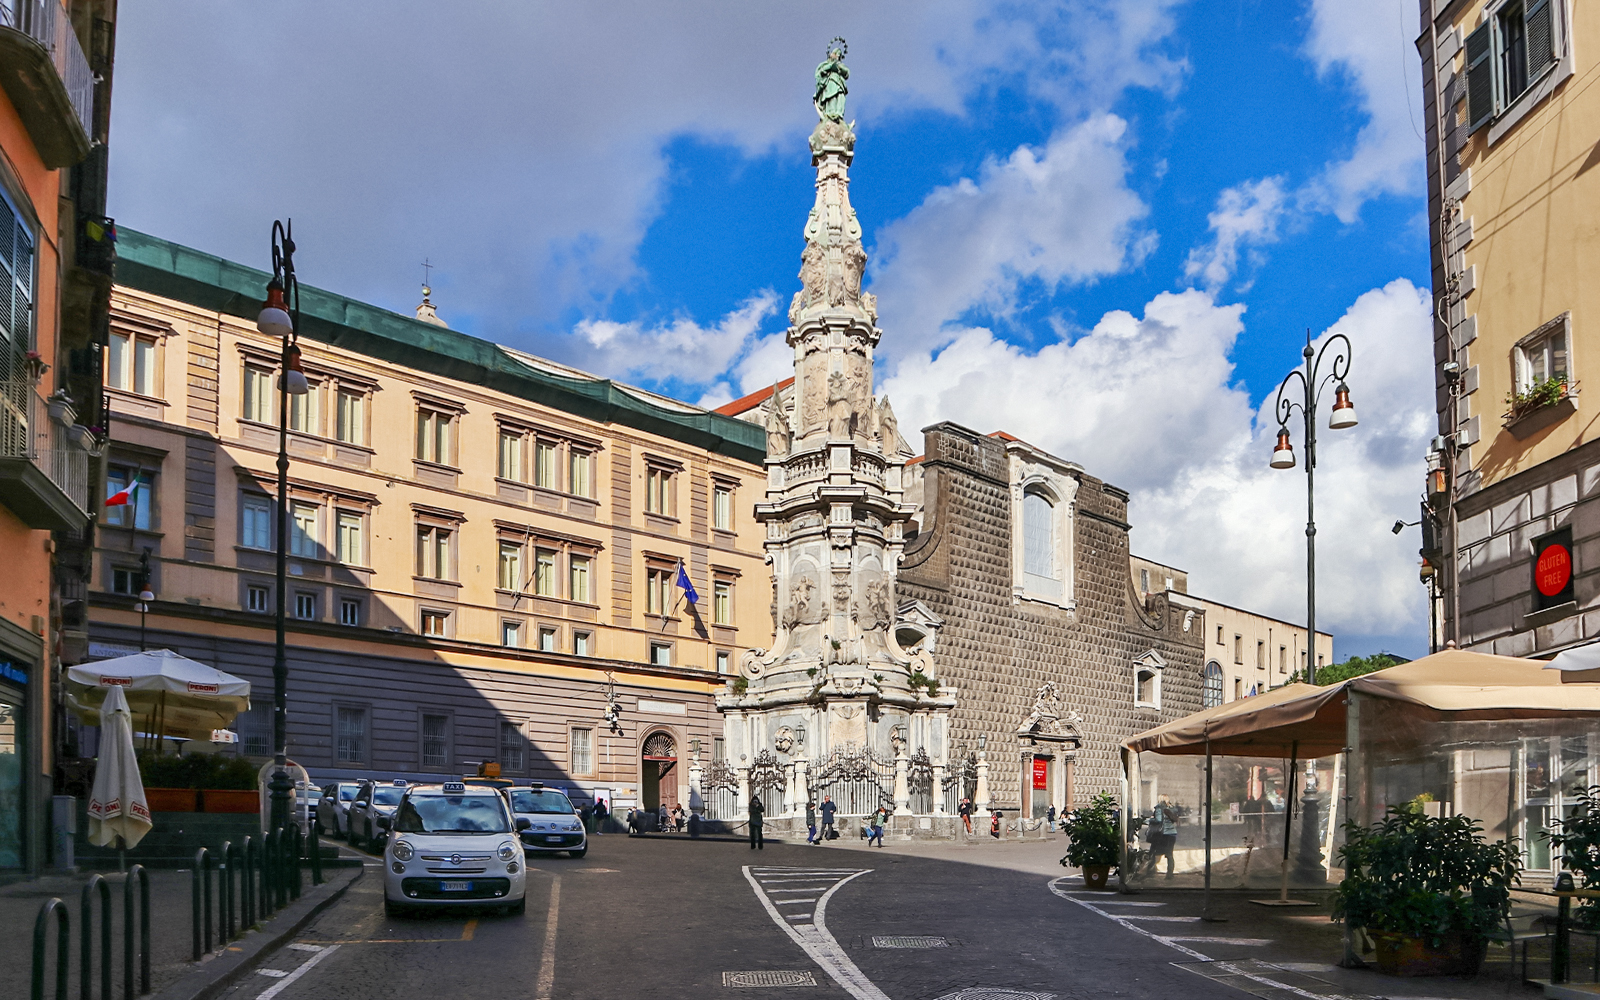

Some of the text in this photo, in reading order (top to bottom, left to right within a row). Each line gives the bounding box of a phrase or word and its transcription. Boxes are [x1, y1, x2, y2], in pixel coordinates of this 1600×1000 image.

[1539, 552, 1566, 572] GLUTEN
[1544, 571, 1562, 587] FREE
[102, 677, 131, 685] PERONI
[190, 684, 217, 692] PERONI
[91, 803, 120, 813] PEONI
